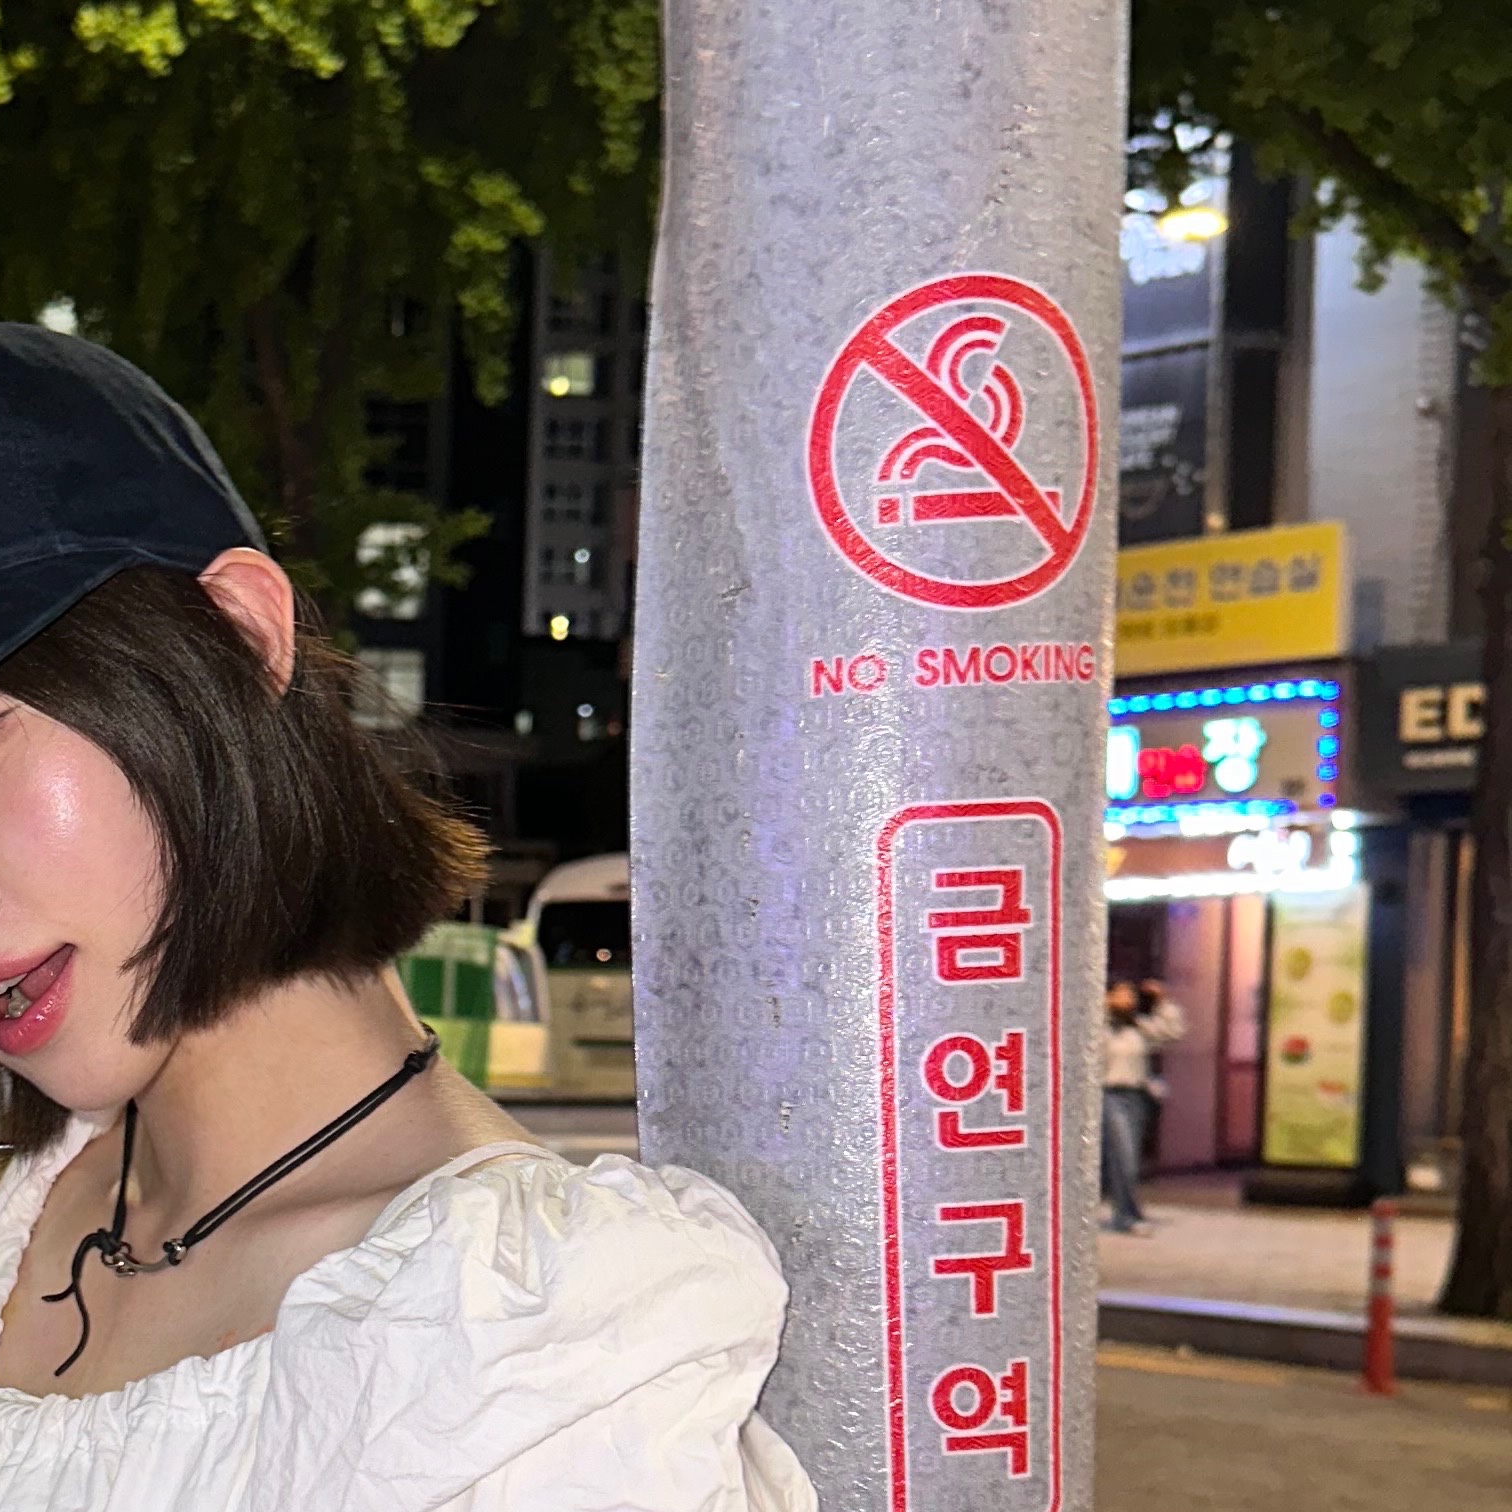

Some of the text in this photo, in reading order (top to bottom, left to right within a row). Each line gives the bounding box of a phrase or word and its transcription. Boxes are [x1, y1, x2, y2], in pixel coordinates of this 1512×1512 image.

[809, 642, 1097, 698] NO SMOKING
[922, 867, 1032, 1480] 금연구역
